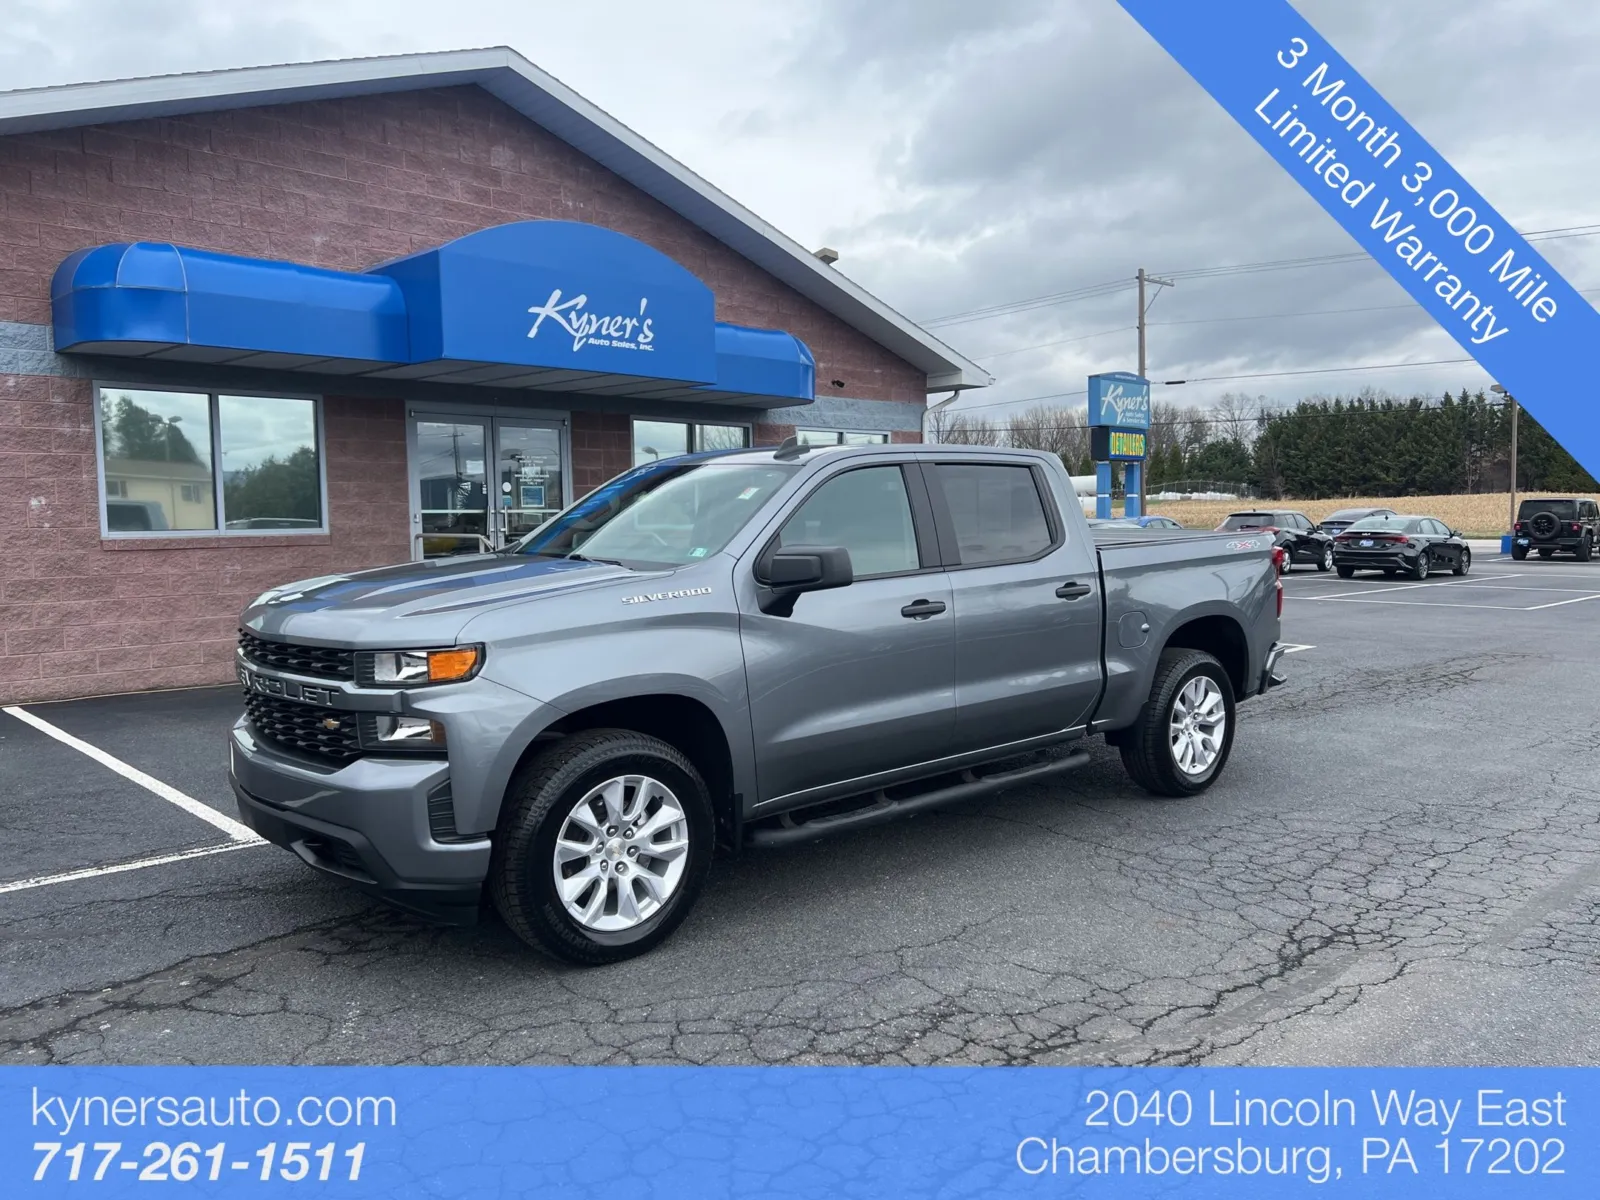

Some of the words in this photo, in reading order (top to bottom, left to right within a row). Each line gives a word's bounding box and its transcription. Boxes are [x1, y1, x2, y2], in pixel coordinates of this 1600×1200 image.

[527, 288, 654, 352] Kyner's
[587, 337, 610, 347] Auto
[611, 339, 638, 350] Sales,
[639, 343, 655, 352] Inc.
[1101, 384, 1148, 424] Kyner's
[621, 586, 713, 605] SILVERADO
